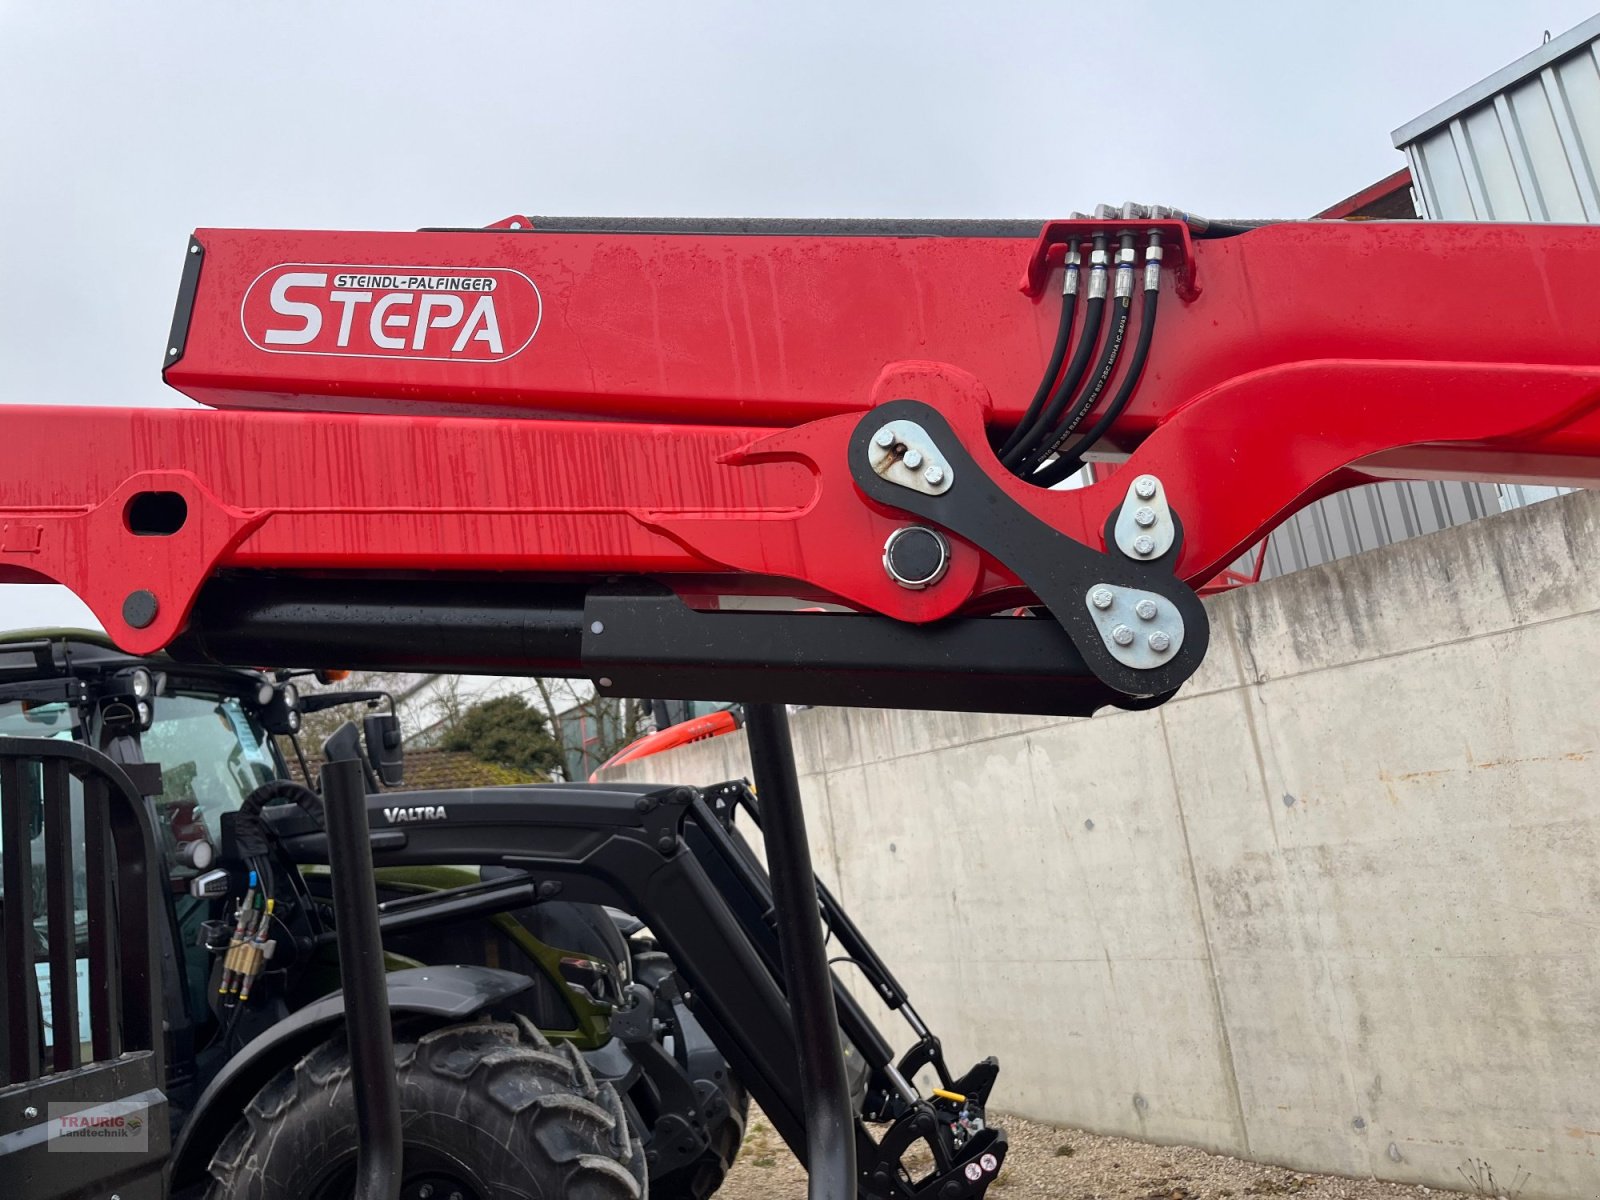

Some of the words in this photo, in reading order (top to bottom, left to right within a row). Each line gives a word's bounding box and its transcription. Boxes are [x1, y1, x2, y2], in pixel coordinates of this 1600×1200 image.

[337, 275, 494, 291] STEINDL-PALFINGER
[264, 272, 504, 354] STEPA
[1069, 416, 1081, 431] BAR
[1080, 402, 1091, 417] EXC
[1089, 392, 1098, 404] EN
[1101, 366, 1111, 380] 2SC
[1108, 344, 1120, 365] MSHA
[383, 806, 448, 823] VALTRA
